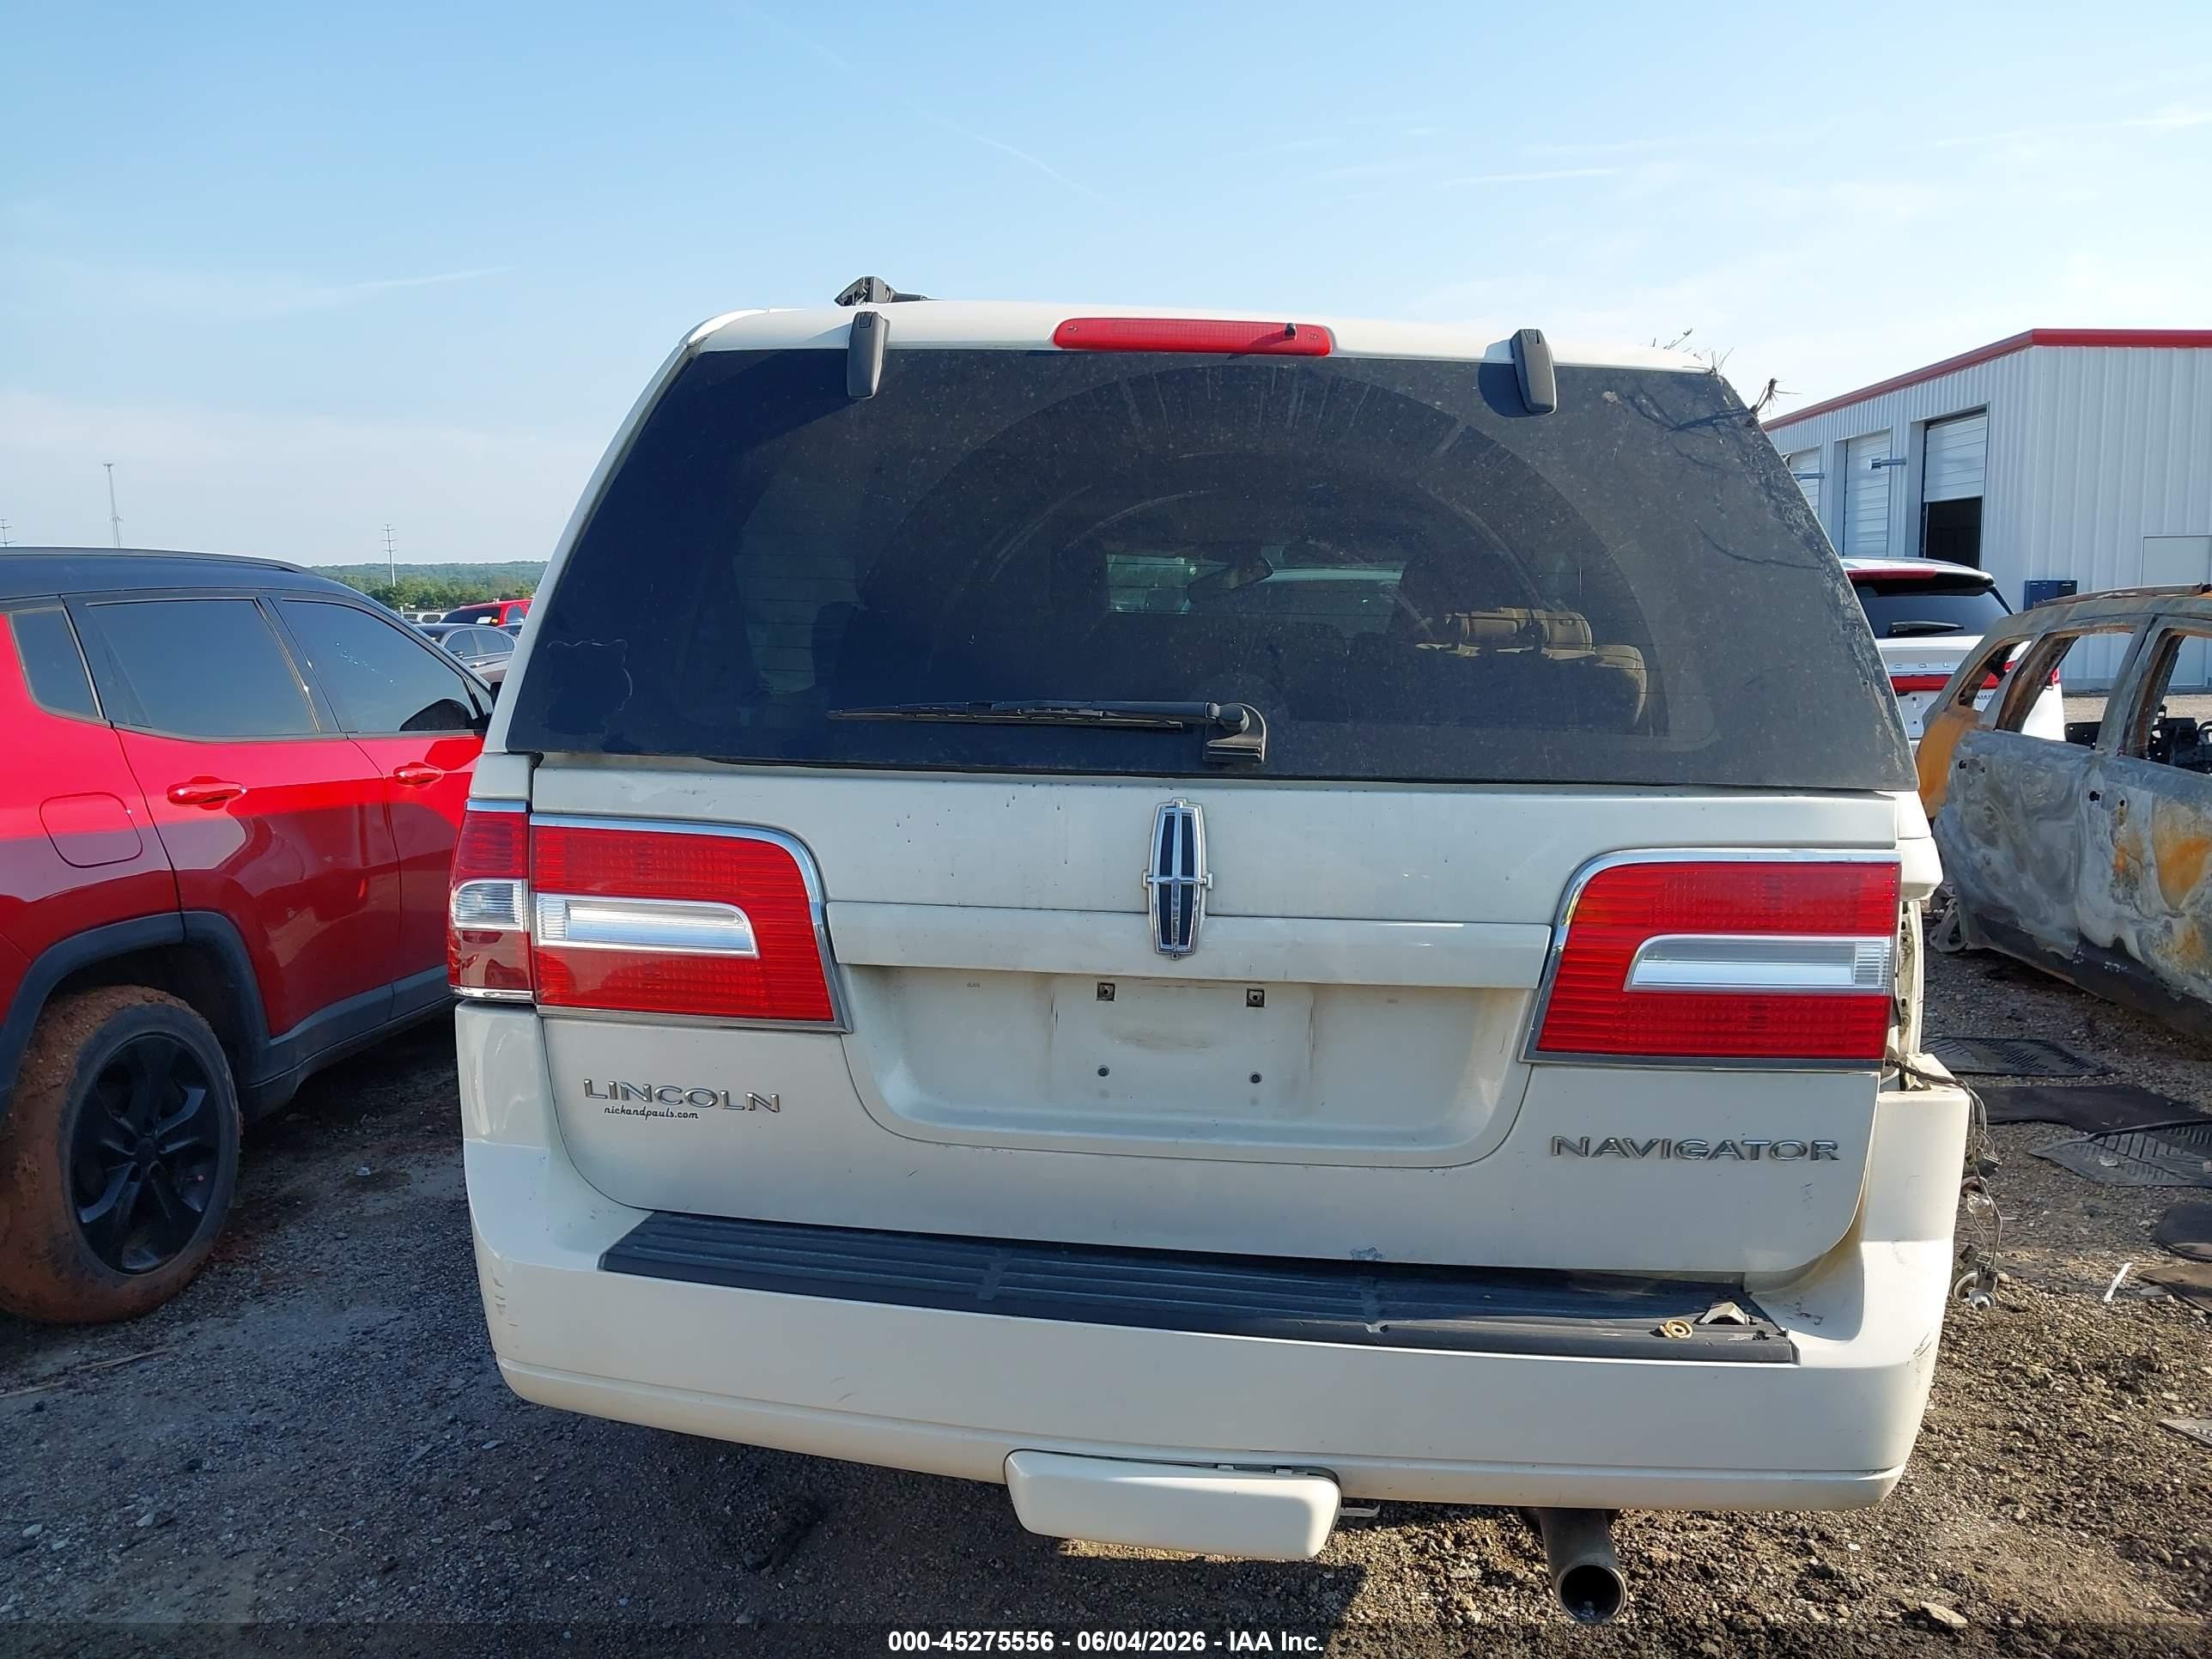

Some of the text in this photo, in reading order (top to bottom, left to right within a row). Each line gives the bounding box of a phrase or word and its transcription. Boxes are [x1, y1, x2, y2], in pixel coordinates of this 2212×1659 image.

[583, 1079, 780, 1113] LINCOLN
[604, 1104, 700, 1120] nickandpauls.com
[1551, 1135, 1841, 1161] NAVIGATOR
